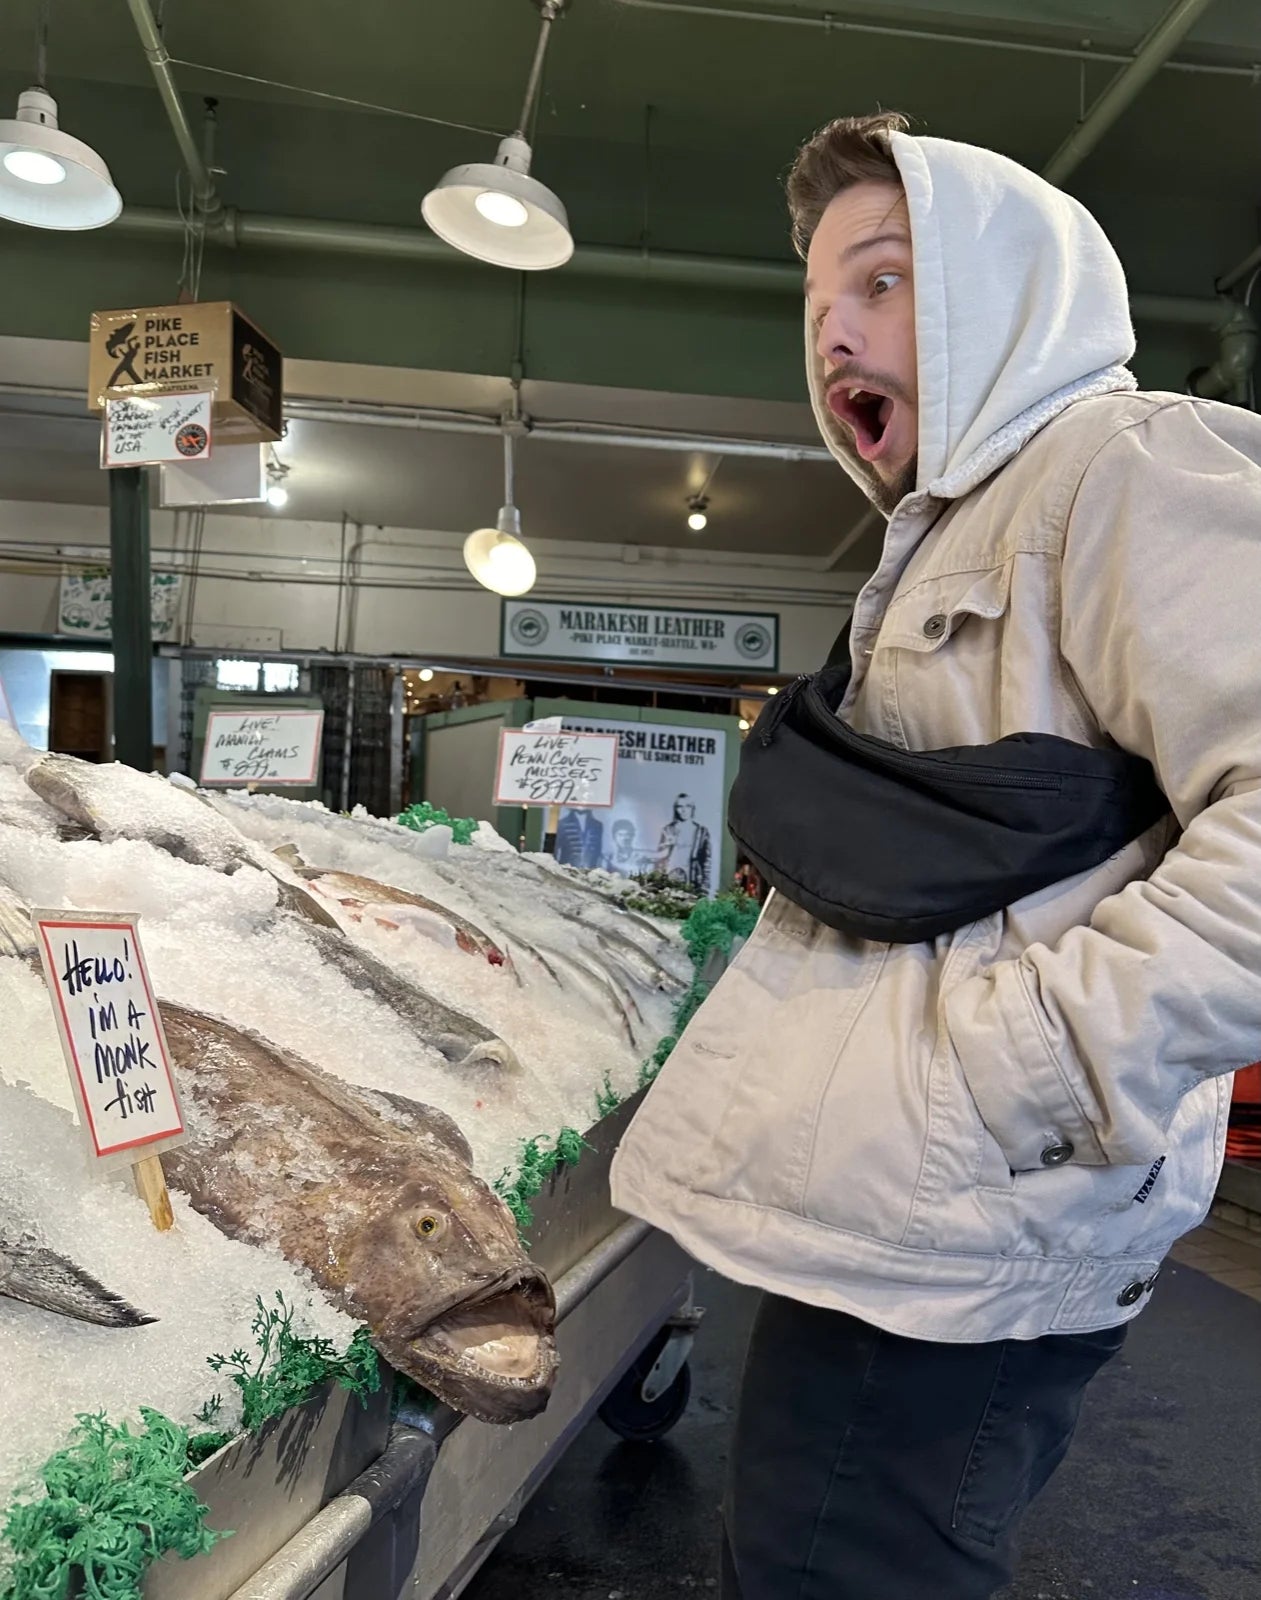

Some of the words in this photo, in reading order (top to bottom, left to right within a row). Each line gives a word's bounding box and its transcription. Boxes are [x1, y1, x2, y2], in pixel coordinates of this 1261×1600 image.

[145, 318, 182, 333] PIKE
[145, 332, 200, 348] PLACE
[144, 350, 181, 365] FISH
[144, 363, 214, 380] MARKET
[114, 439, 142, 454] USA
[560, 610, 648, 633] MARAKESH
[654, 615, 725, 638] LEATHER
[650, 732, 717, 755] LEATHER
[247, 745, 300, 761] CLAMS
[510, 744, 549, 767] PENN
[550, 750, 604, 767] COVE
[654, 752, 682, 764] SINCE
[684, 754, 704, 766] 1971
[524, 765, 603, 782] MUSSELS
[62, 937, 133, 996] HELLO!
[127, 999, 146, 1030] A
[95, 1033, 157, 1084] MONK
[1136, 1159, 1162, 1202] BKLYN
